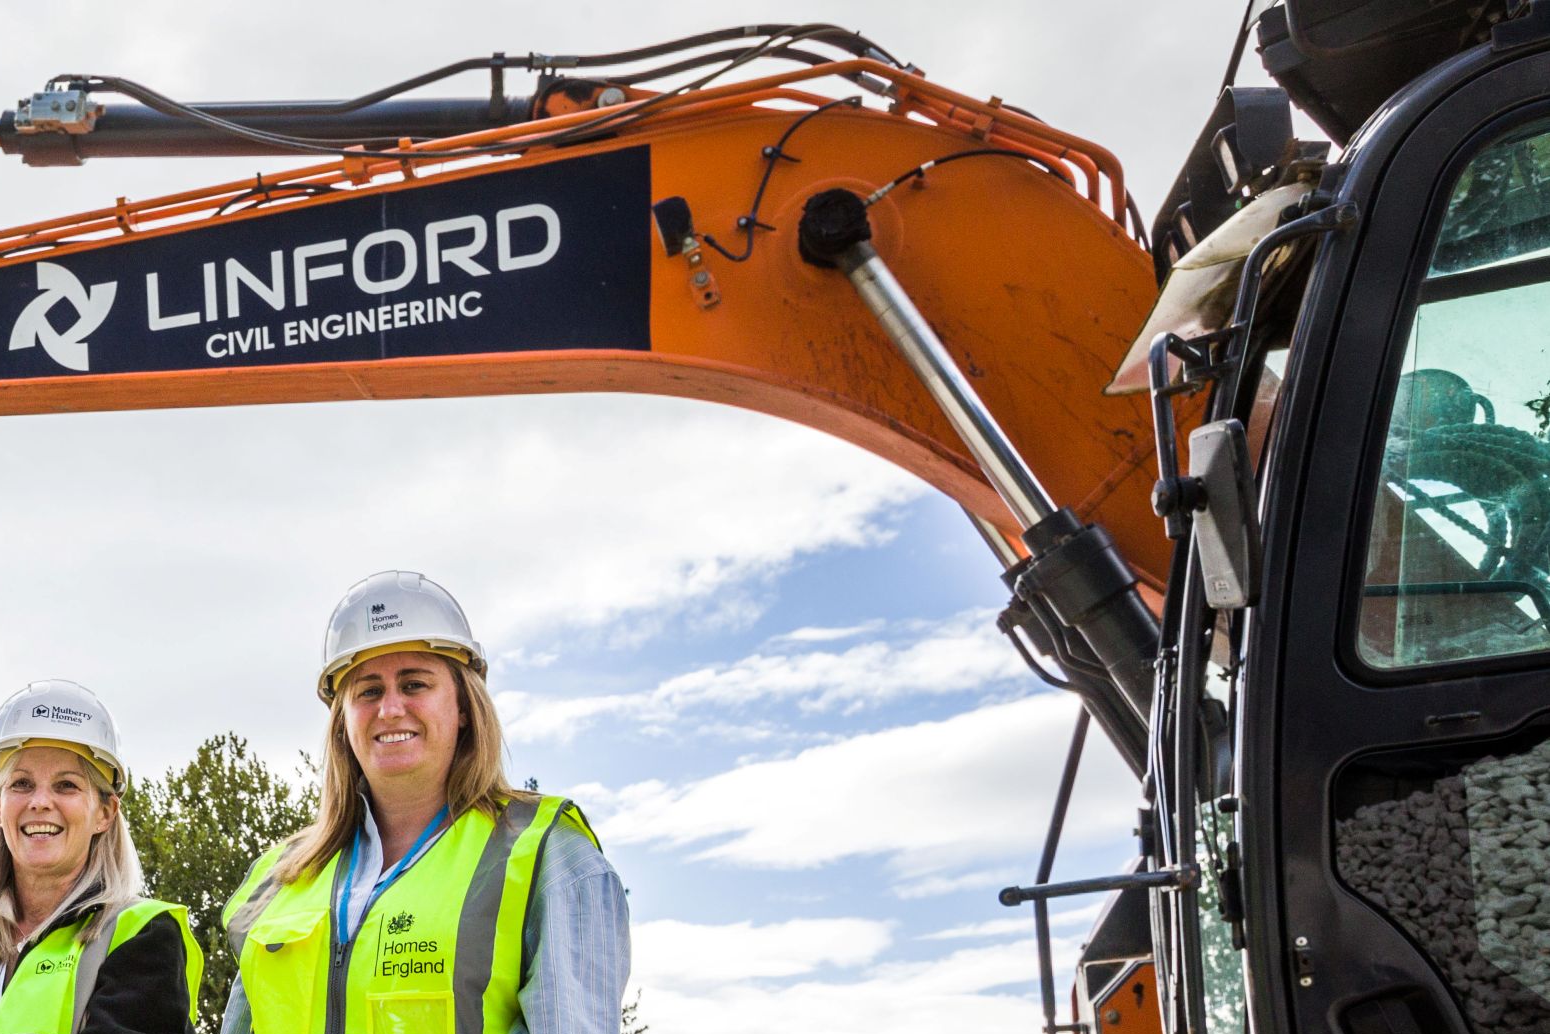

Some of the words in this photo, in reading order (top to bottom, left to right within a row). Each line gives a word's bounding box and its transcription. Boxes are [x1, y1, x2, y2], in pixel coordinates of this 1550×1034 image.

[146, 203, 561, 331] LINFORD
[205, 325, 276, 359] CIVIL
[283, 290, 484, 347] ENGINEERINC
[371, 613, 399, 624] Homes
[372, 620, 403, 632] England
[51, 712, 83, 724] Homes
[52, 705, 93, 721] Mulberry
[383, 940, 438, 957] Homes
[382, 958, 445, 978] England
